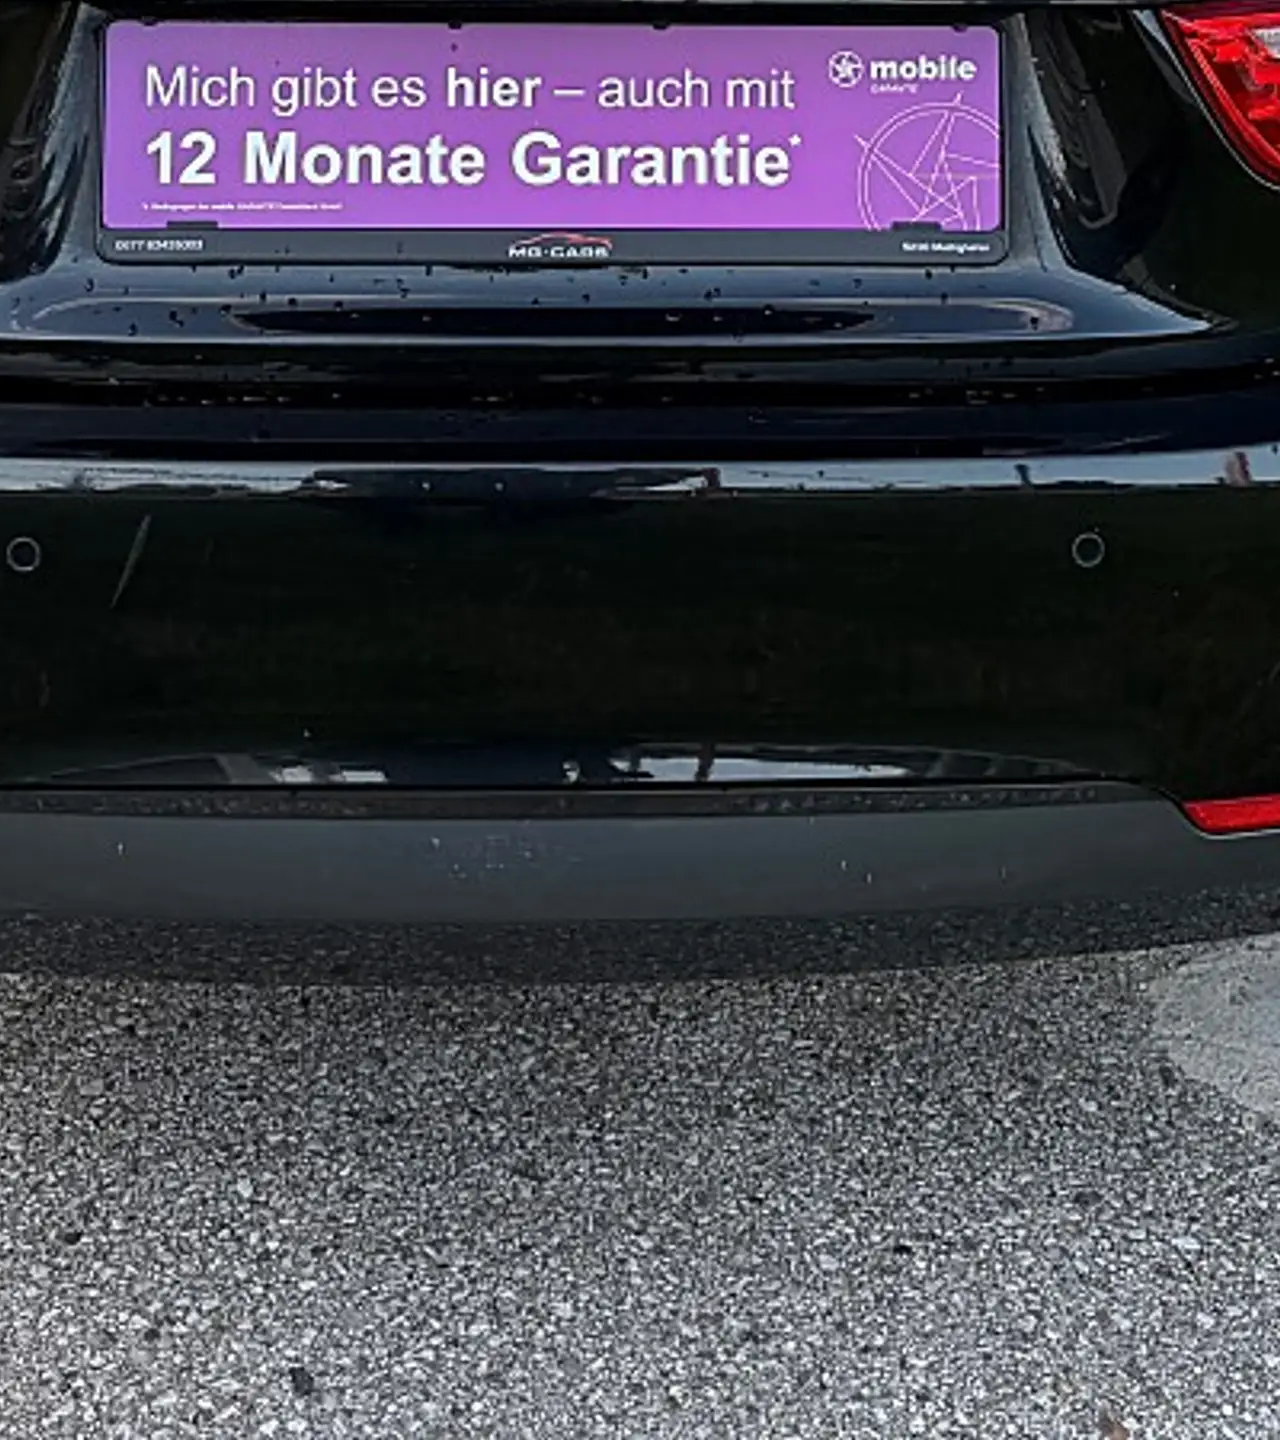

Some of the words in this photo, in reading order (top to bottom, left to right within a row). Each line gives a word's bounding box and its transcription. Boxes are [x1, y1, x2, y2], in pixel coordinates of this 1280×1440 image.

[146, 65, 255, 108] Mich
[272, 66, 358, 117] gibt
[372, 75, 427, 108] es
[447, 66, 542, 108] hier
[597, 68, 709, 109] auch
[726, 68, 796, 109] mit
[870, 54, 977, 79] mobile
[146, 131, 217, 185] 12
[243, 130, 486, 186] Monate
